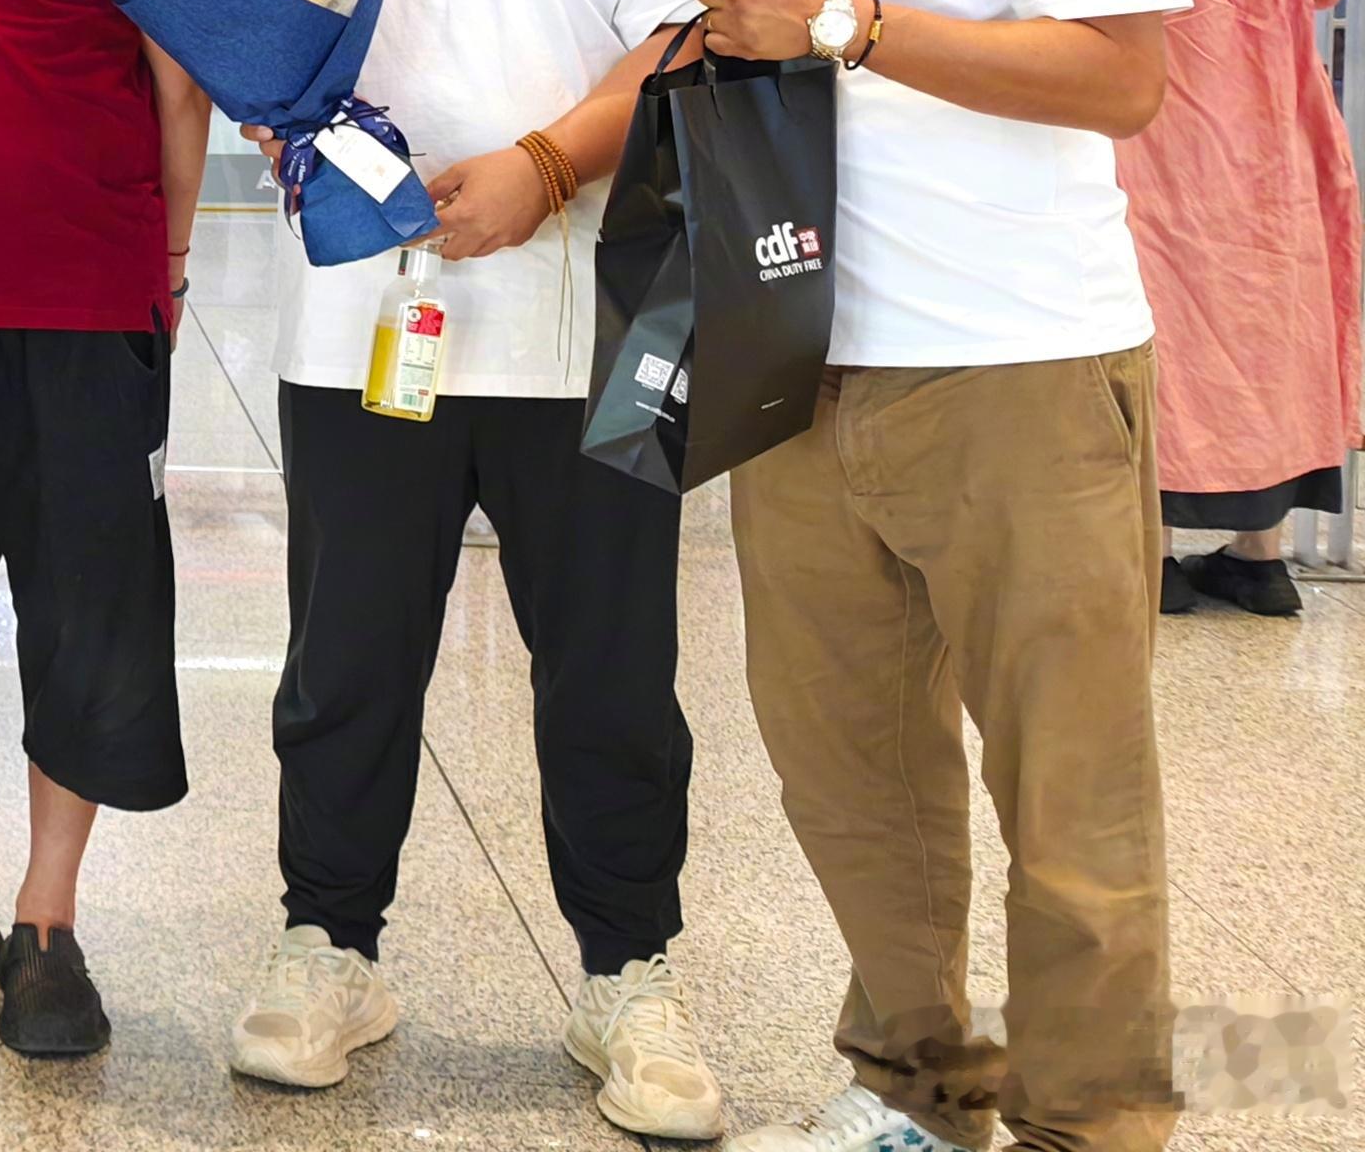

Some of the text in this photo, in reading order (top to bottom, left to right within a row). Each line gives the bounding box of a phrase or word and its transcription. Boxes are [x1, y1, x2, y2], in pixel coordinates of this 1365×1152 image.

[755, 221, 799, 267] cdf
[781, 261, 805, 277] DUTY
[803, 257, 823, 272] FREE
